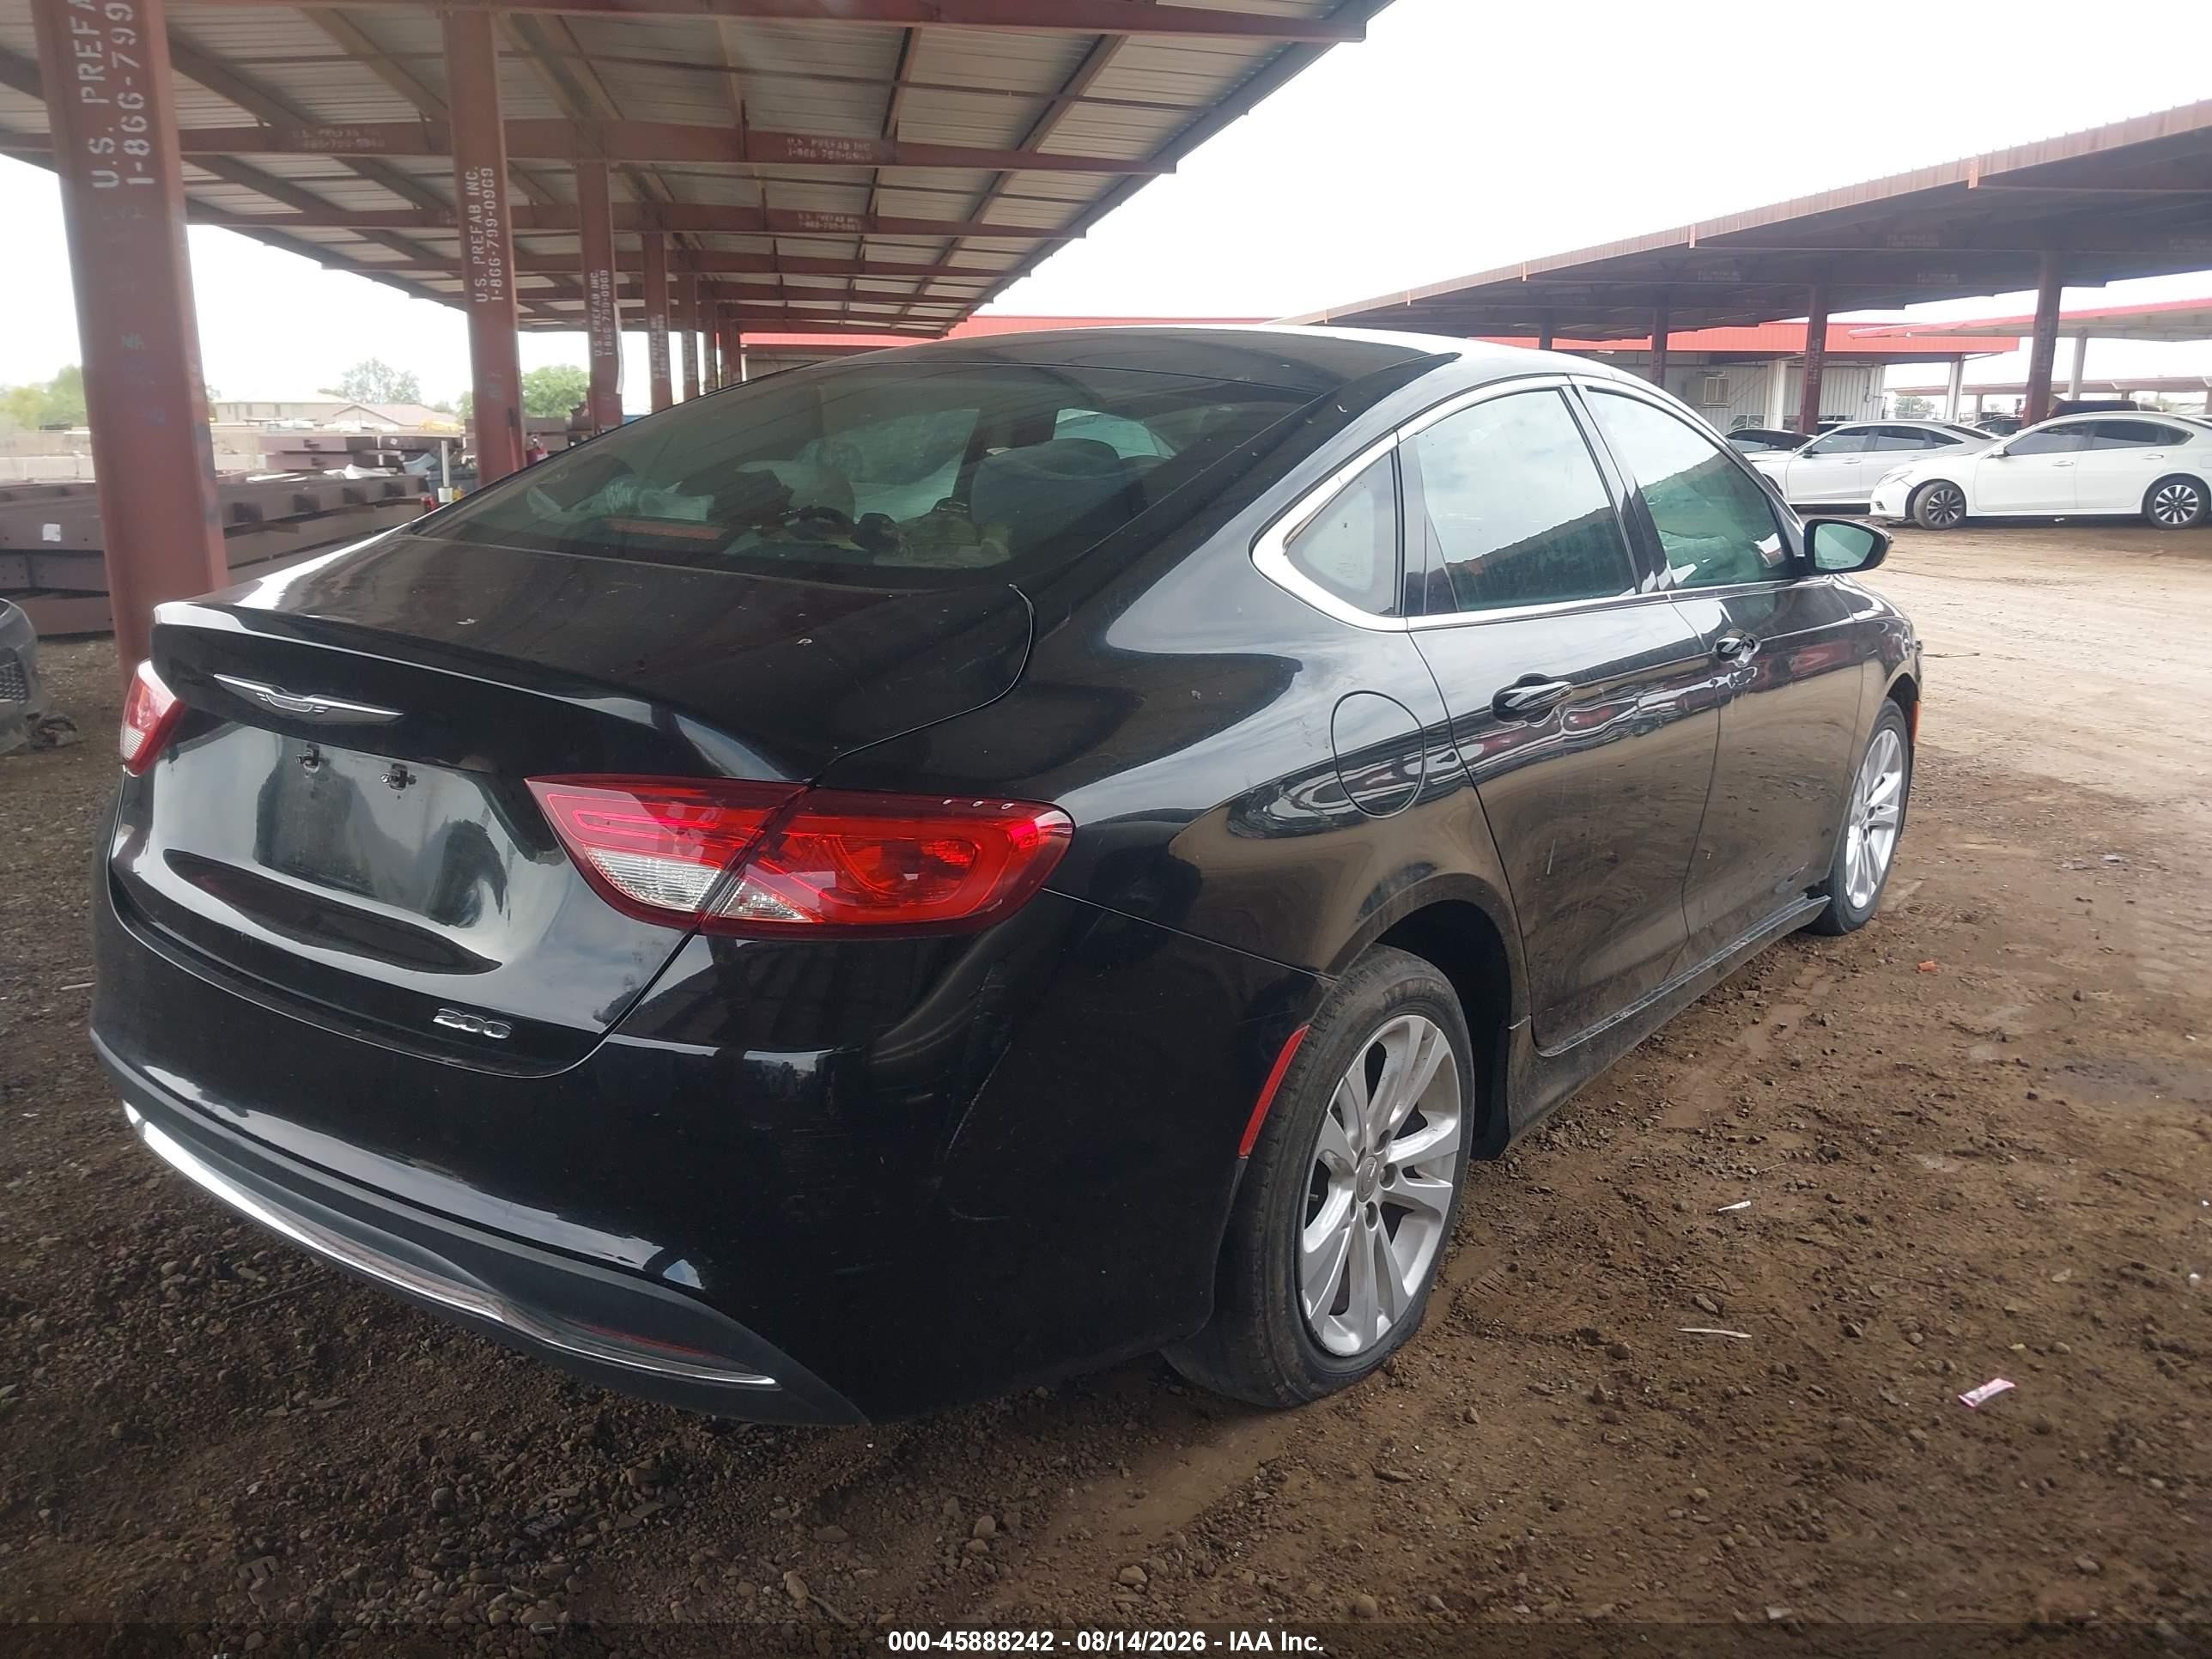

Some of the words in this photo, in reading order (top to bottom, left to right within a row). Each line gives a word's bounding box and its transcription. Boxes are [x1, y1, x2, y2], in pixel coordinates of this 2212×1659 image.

[88, 127, 120, 188] U.S.
[465, 166, 480, 196] INC.
[468, 204, 485, 264] PREFAB
[481, 167, 504, 301] 1-866-799-0969
[474, 274, 489, 302] U.S.
